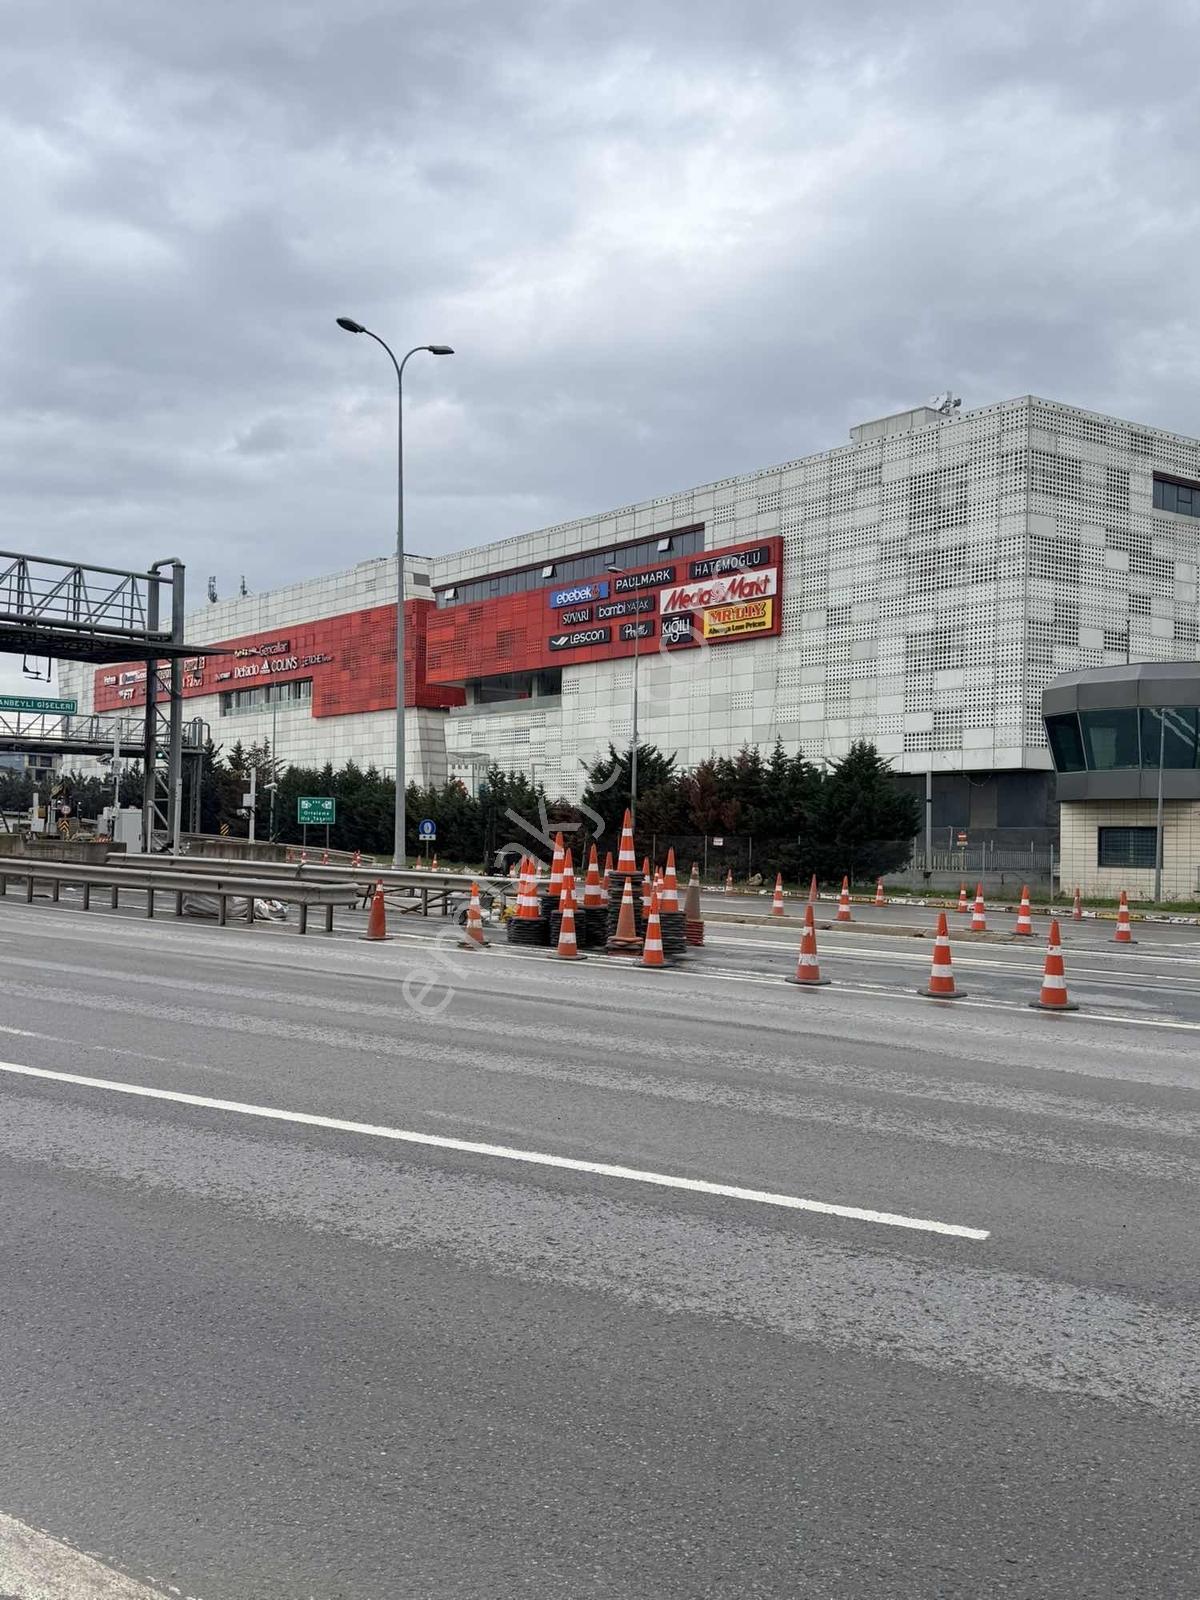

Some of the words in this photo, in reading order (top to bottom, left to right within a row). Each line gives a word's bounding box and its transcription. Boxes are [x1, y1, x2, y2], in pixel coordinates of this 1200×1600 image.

[694, 551, 760, 576] HATEMOĞLU
[615, 568, 671, 590] PAULMARK
[556, 586, 592, 604] ebebek
[664, 588, 713, 612] Media
[725, 575, 770, 599] Markt
[598, 602, 625, 618] bambi
[627, 599, 648, 612] YATAK
